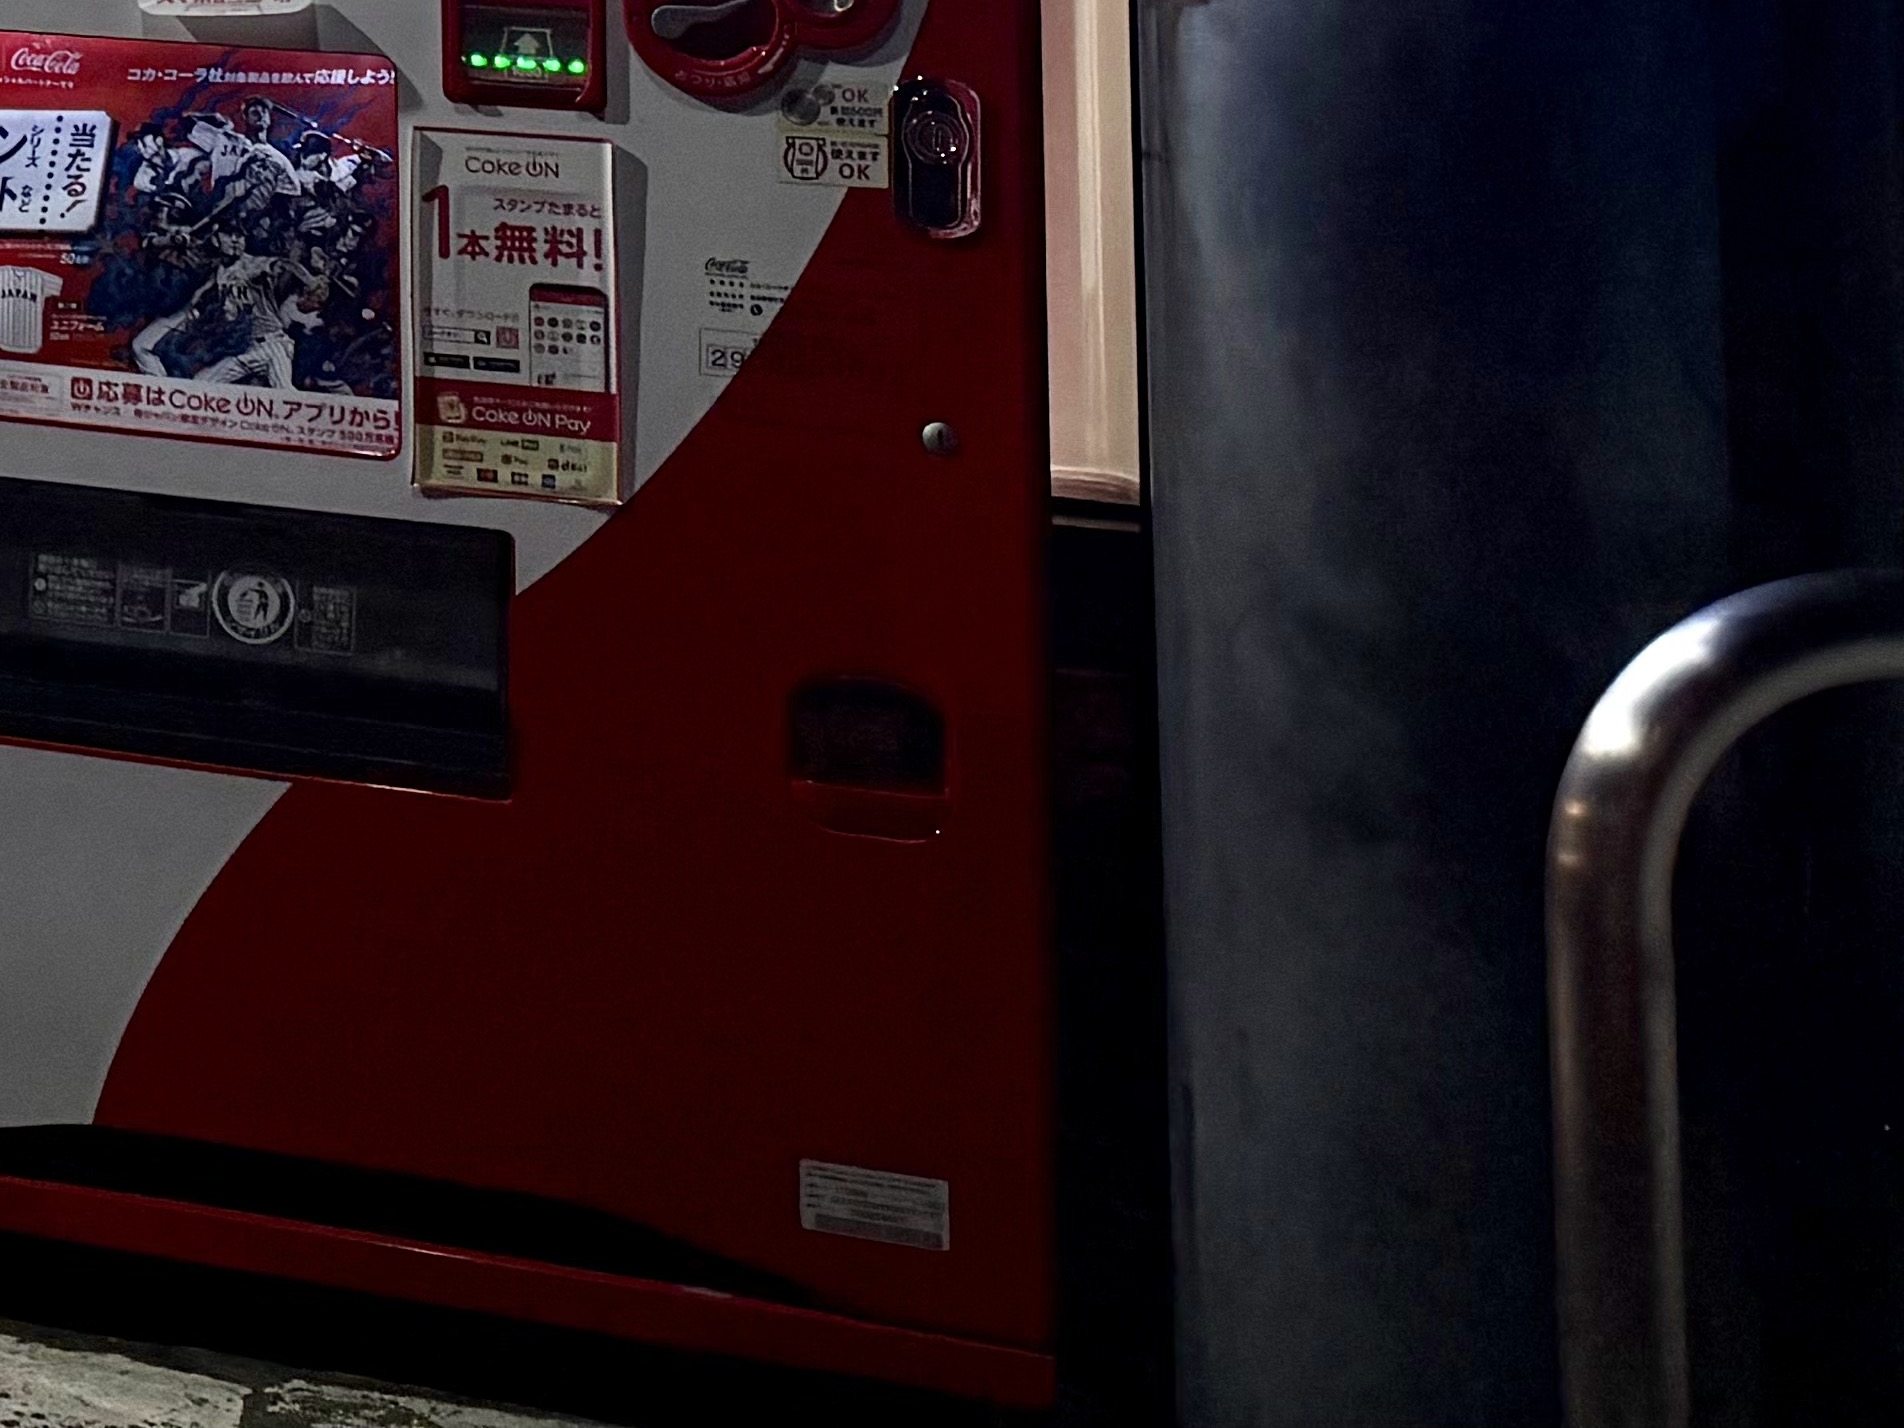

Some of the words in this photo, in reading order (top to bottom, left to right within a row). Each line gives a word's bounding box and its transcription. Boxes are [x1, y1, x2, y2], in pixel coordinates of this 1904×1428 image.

[10, 47, 83, 75] Coca-Cola
[842, 88, 869, 103] OK
[464, 156, 522, 176] Coke
[525, 157, 560, 179] ON
[838, 162, 870, 181] OK
[18, 184, 32, 213] など
[493, 197, 602, 219] スタンプたまると
[422, 184, 603, 271] 1本無料!
[1, 288, 38, 303] JAPAN
[472, 405, 520, 425] Coke
[522, 408, 551, 427] ON
[555, 414, 591, 435] Pay
